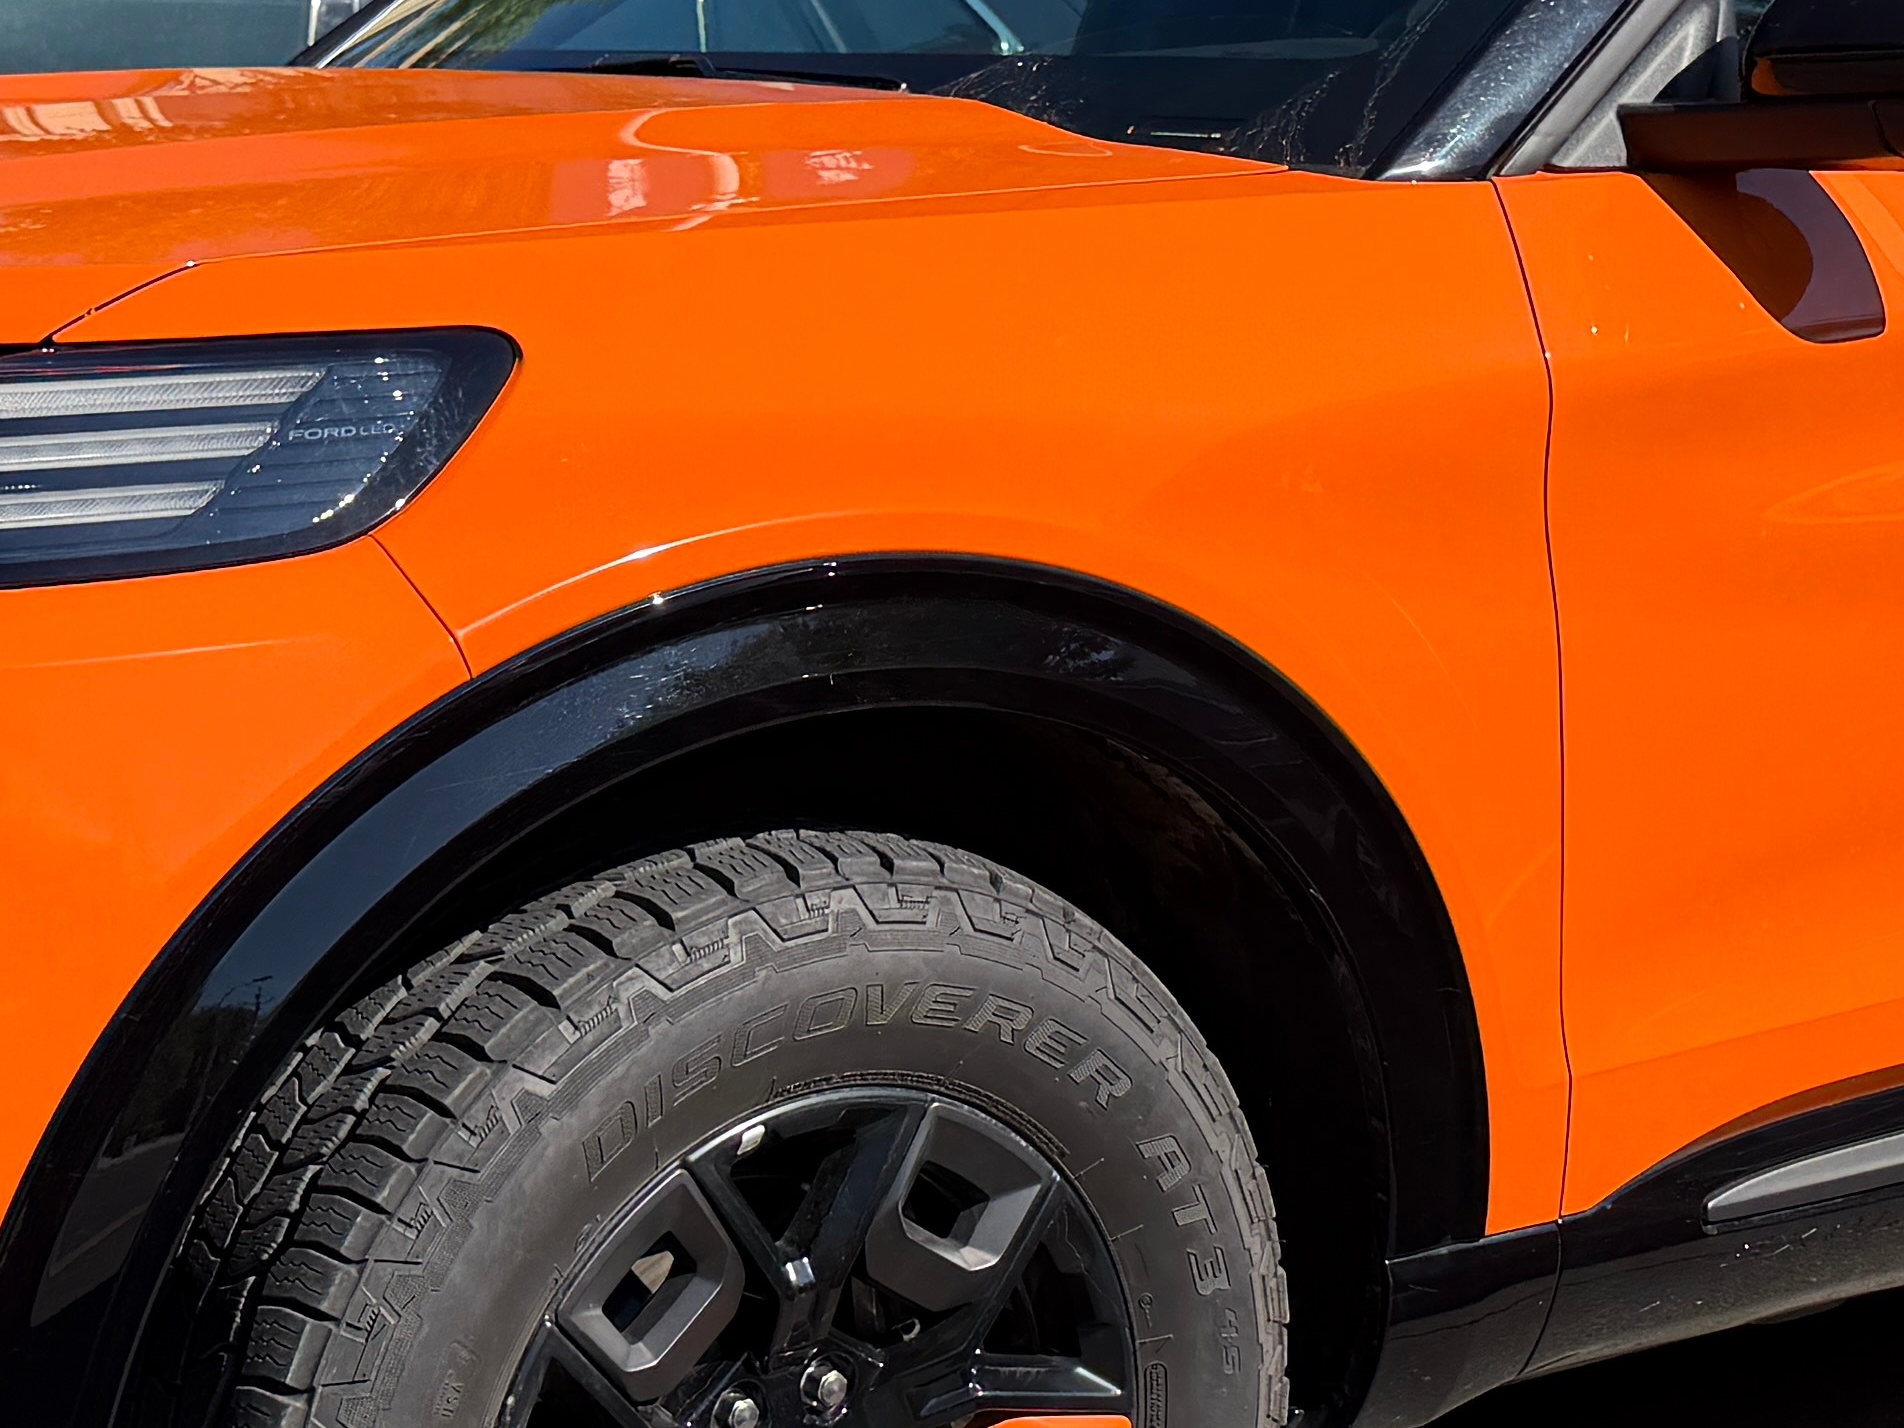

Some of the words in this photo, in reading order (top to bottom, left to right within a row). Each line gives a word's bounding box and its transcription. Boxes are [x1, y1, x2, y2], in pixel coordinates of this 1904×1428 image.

[288, 425, 357, 441] FORD
[581, 980, 1134, 1183] DISCOVERER
[1134, 1132, 1232, 1299] AT3
